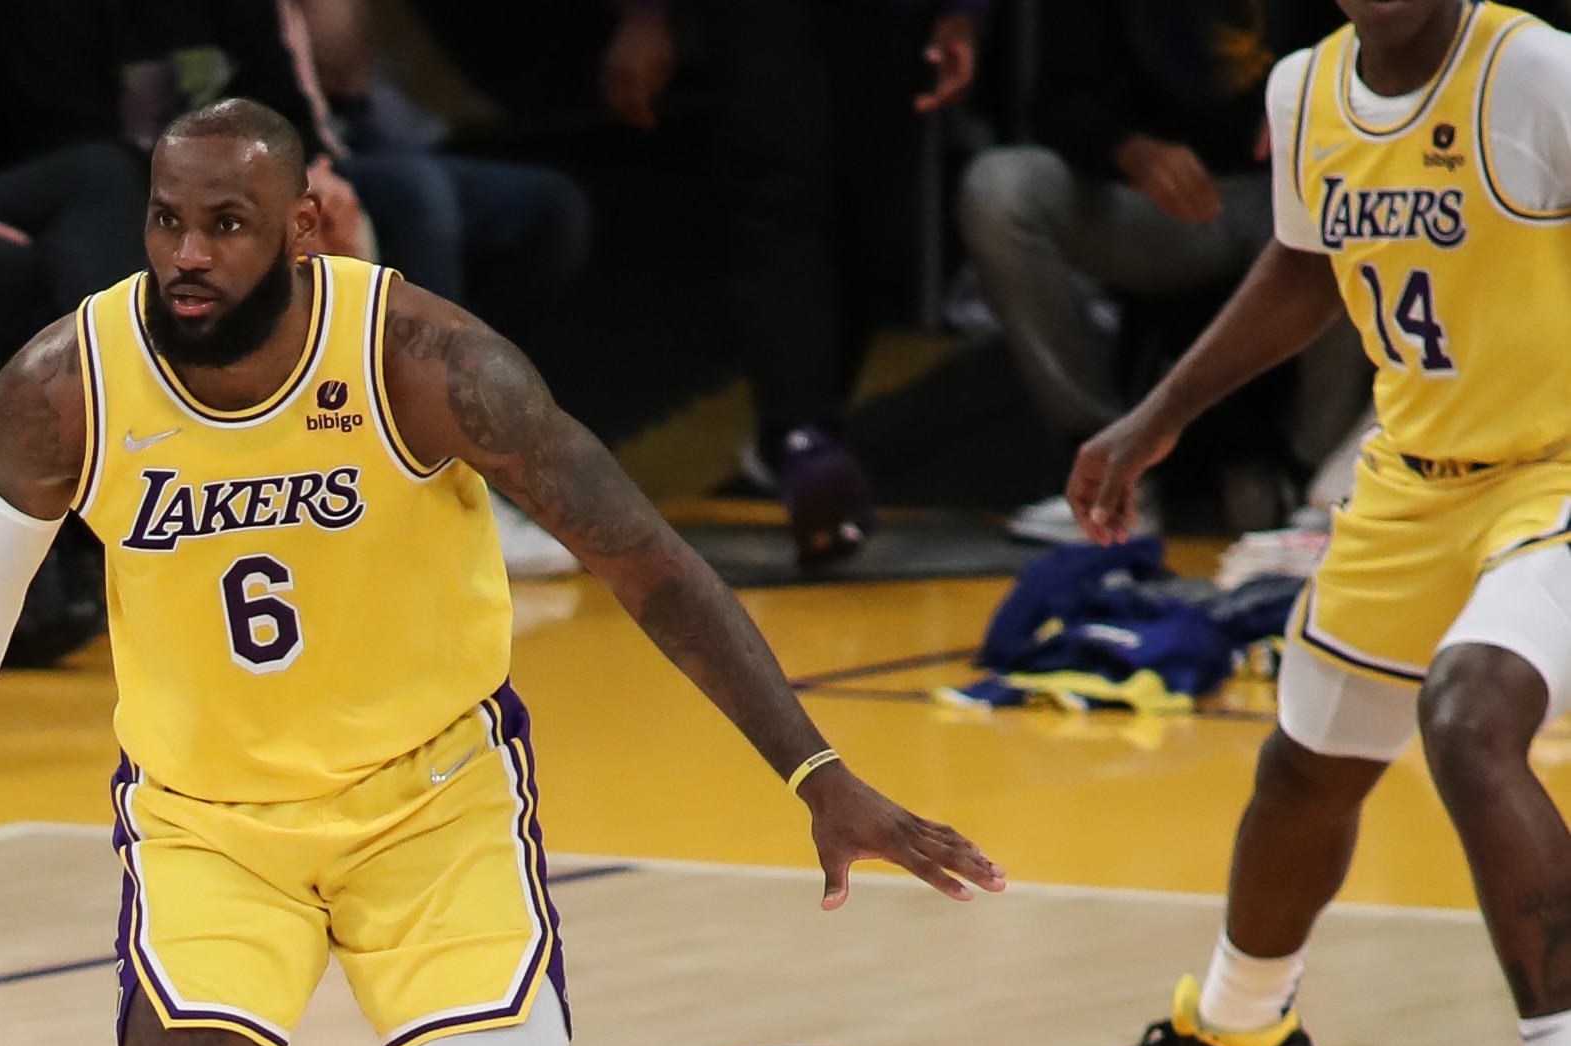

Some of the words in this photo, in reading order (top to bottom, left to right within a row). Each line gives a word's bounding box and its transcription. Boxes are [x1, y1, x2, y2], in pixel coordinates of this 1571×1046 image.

[1320, 173, 1466, 251] LAKERS
[1359, 262, 1458, 378] 14
[306, 412, 363, 432] bibigo
[119, 466, 367, 552] LAKERS
[219, 553, 305, 675] 6
